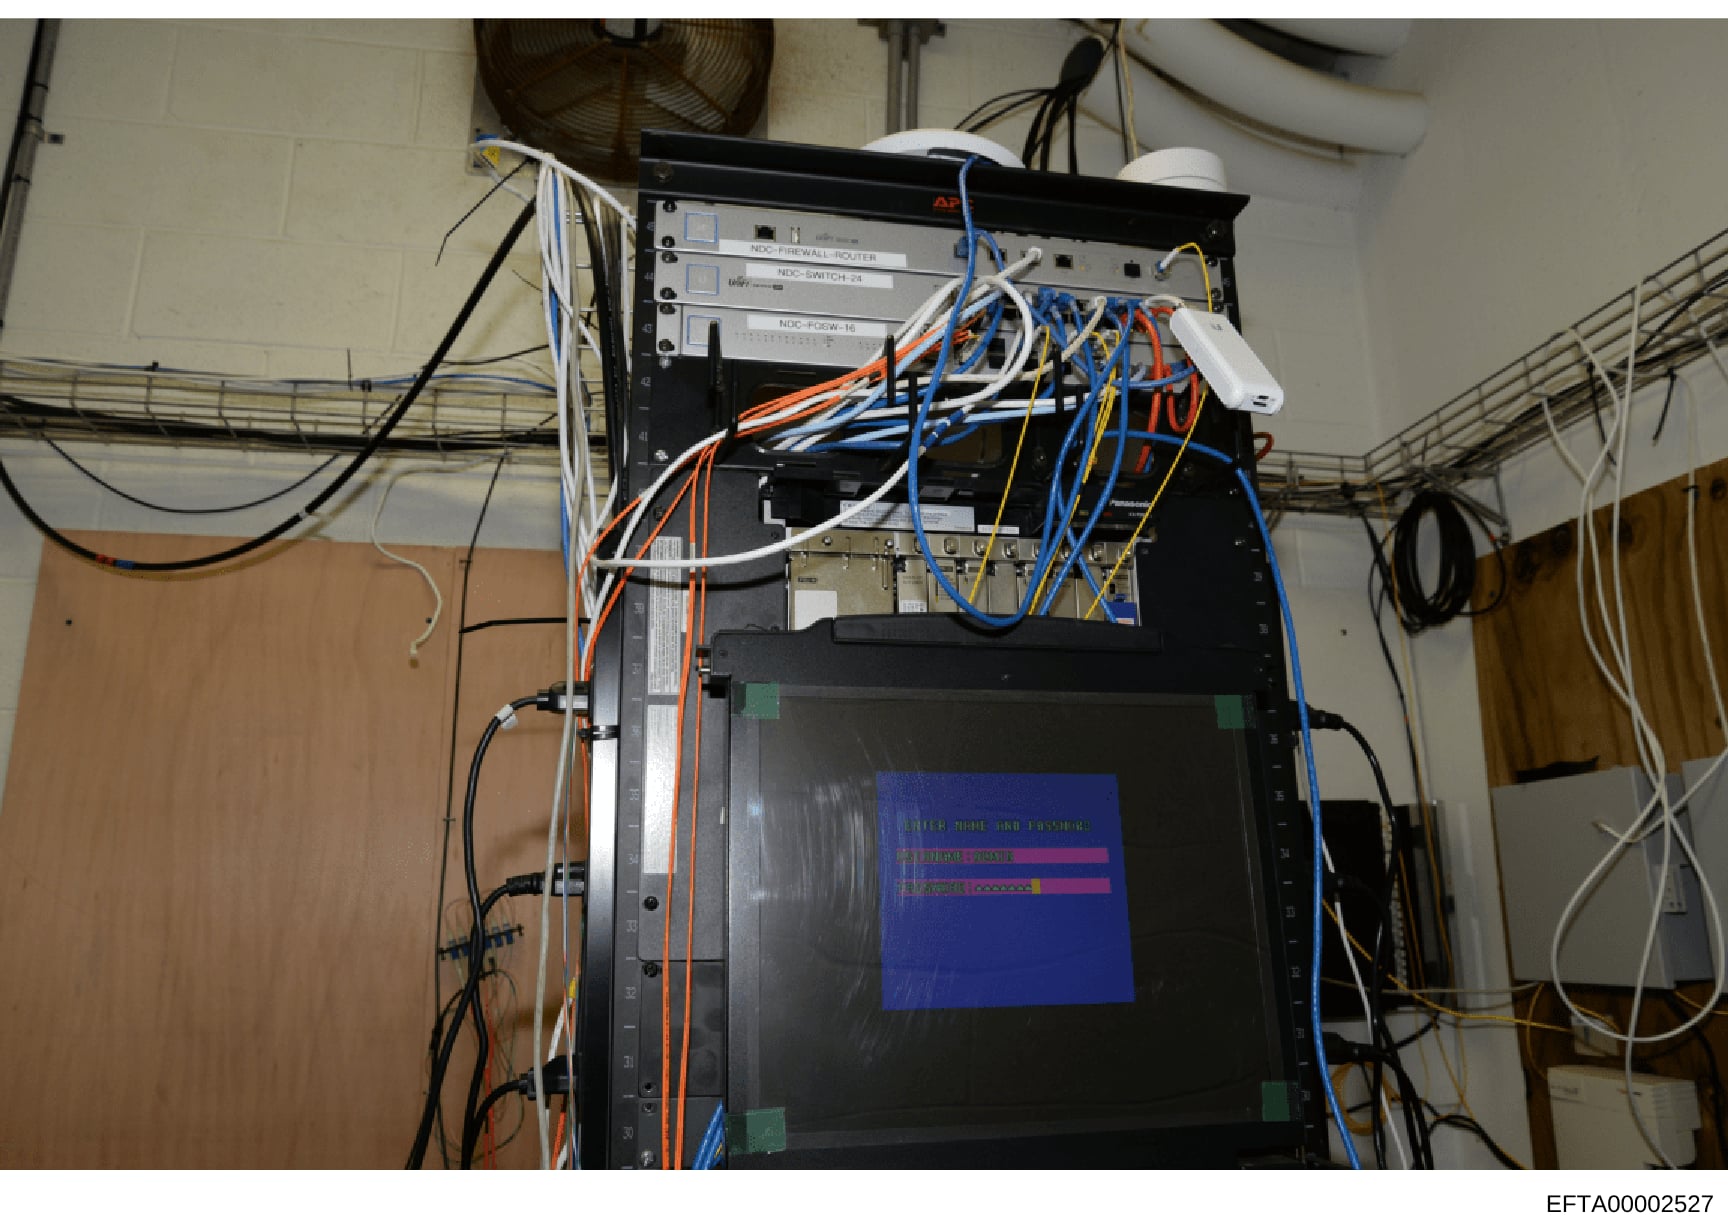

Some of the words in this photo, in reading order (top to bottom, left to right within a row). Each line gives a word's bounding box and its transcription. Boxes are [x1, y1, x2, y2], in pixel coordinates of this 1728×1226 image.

[751, 243, 877, 262] NDC-FIREWALL-ROUTER
[777, 267, 862, 283] NDC-SWITCH-24
[996, 820, 1020, 832] AND
